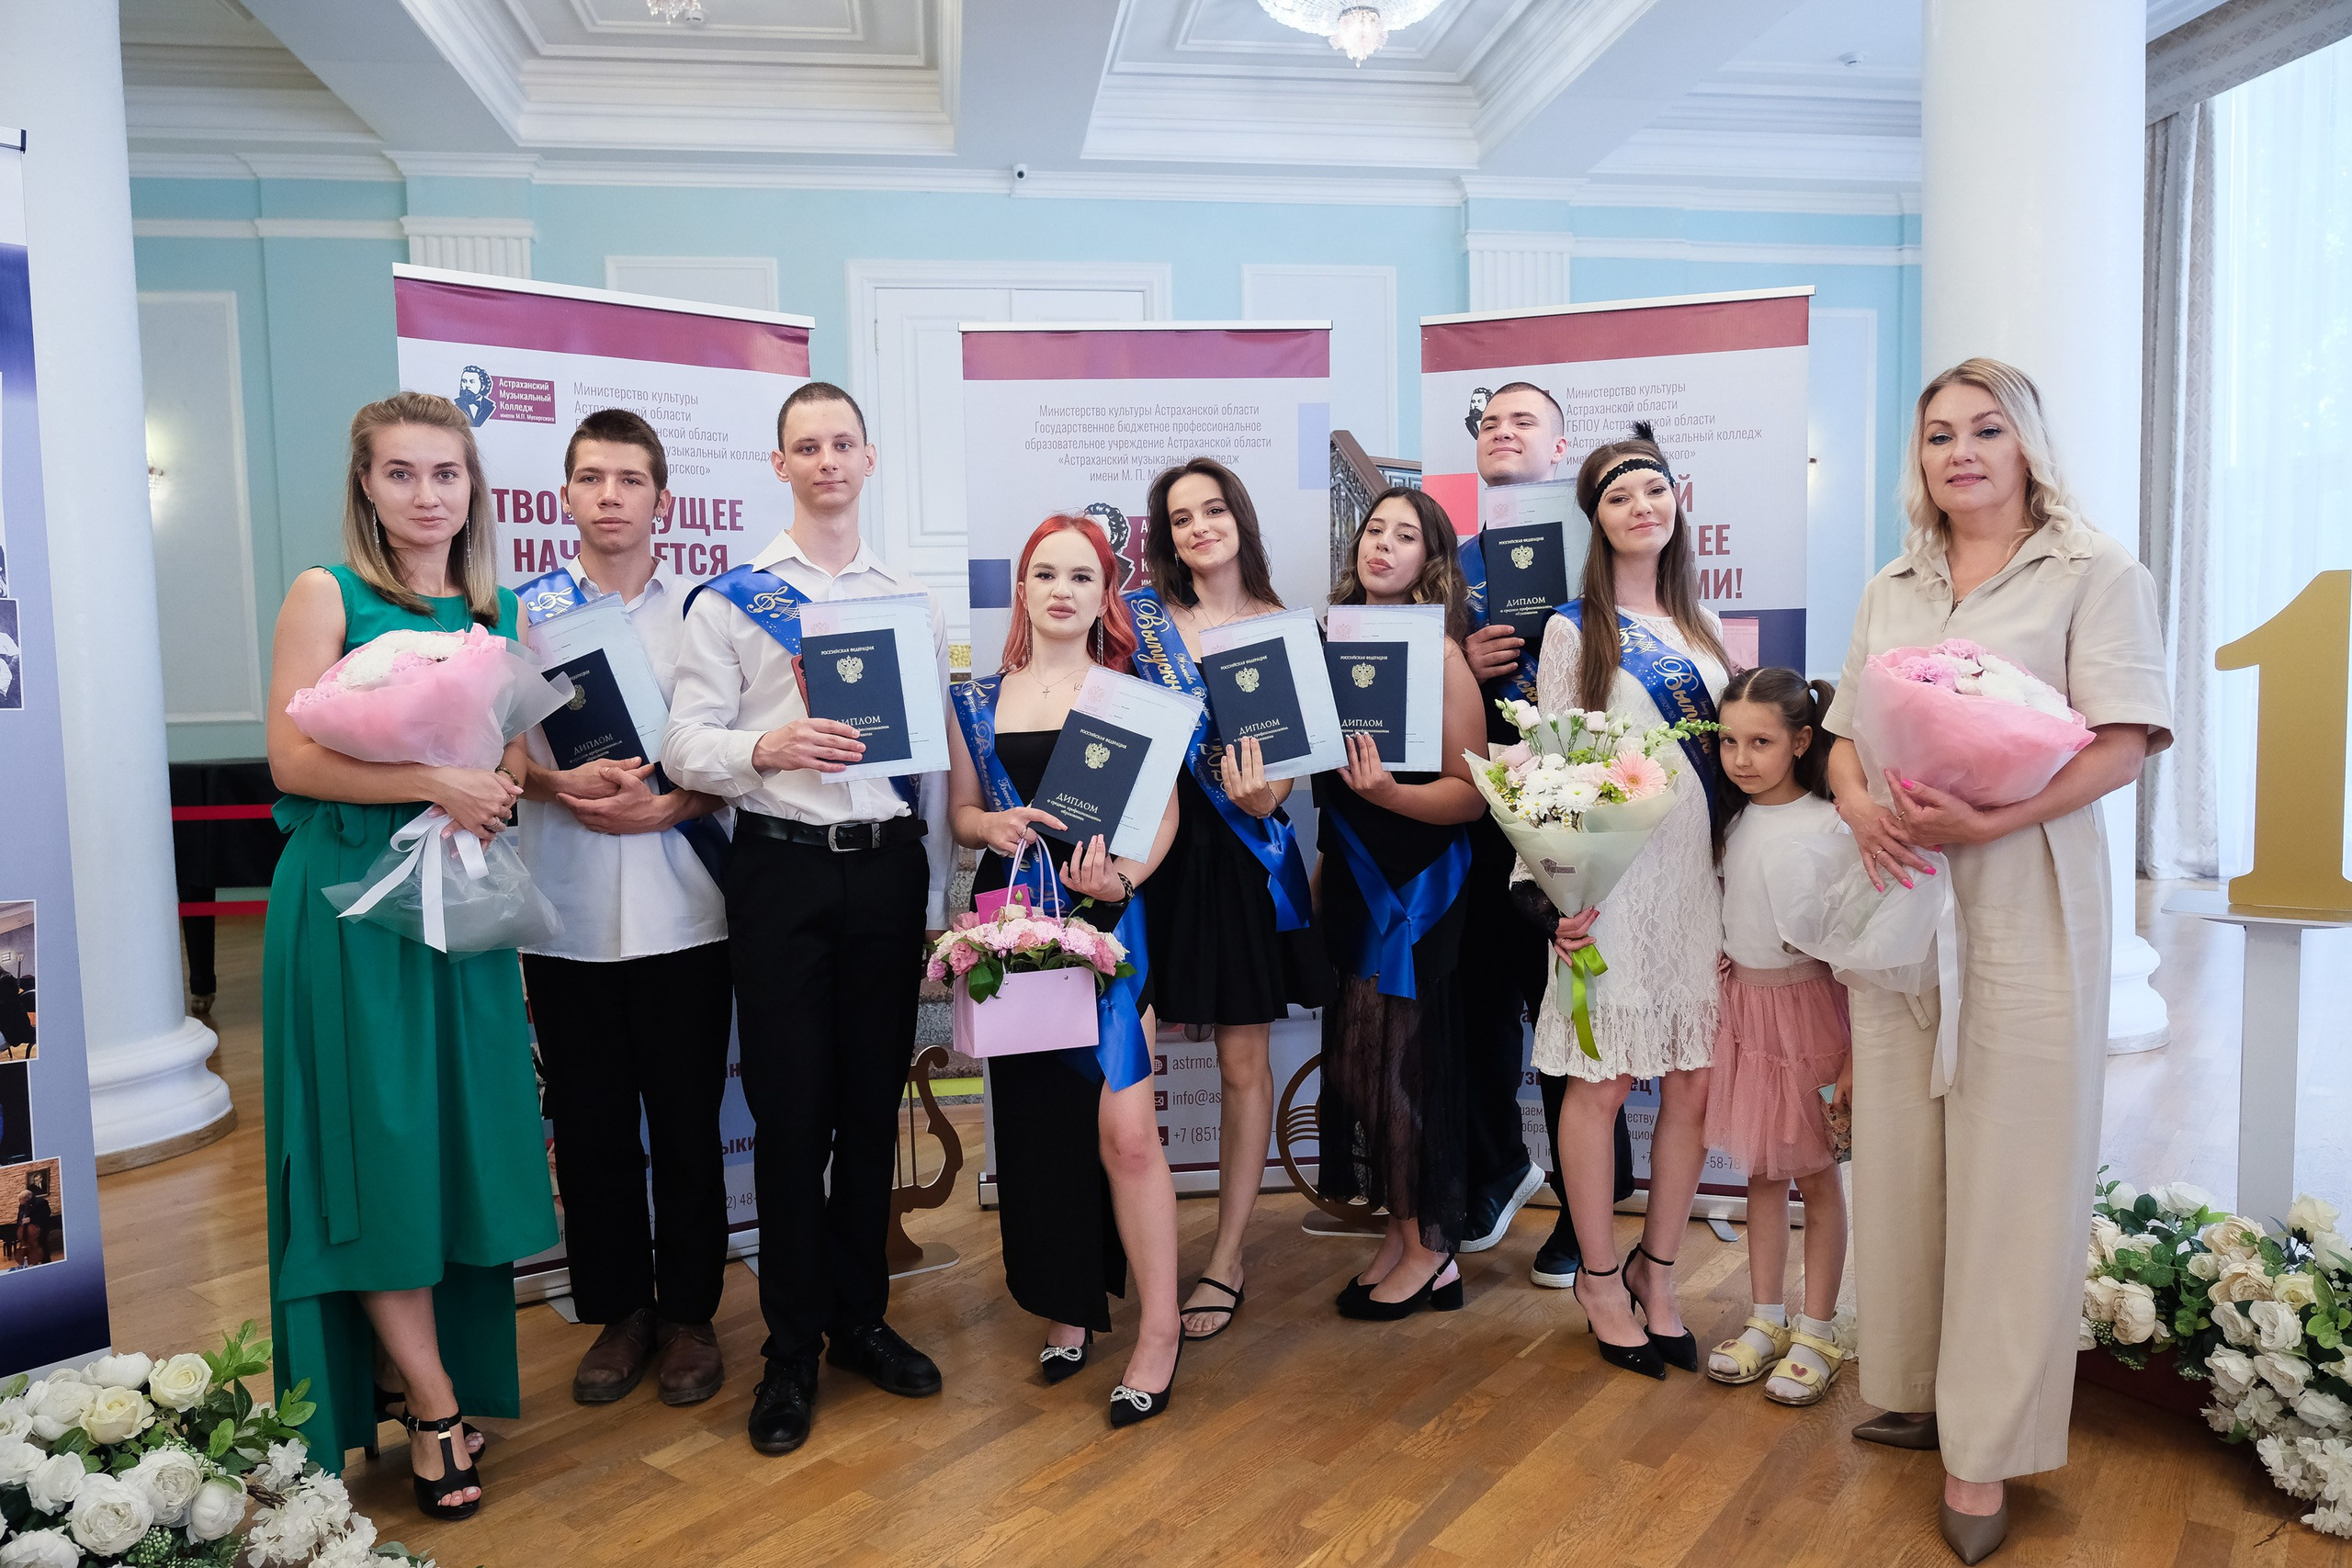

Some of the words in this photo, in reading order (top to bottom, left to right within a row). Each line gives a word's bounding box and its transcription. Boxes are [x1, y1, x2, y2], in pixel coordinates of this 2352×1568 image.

[499, 378, 549, 391] Астраханский
[1566, 384, 1636, 400] Министерство
[1639, 382, 1686, 399] культуры
[499, 389, 551, 402] Музыкальный
[573, 382, 649, 400] Министерство
[651, 391, 698, 405] культуры
[500, 400, 534, 412] Колледж
[1039, 404, 1106, 418] Министерство
[1108, 406, 1152, 418] культуры
[1155, 403, 1219, 418] Астраханской
[1221, 402, 1260, 416] области
[1566, 400, 1634, 417] Астраханской
[1637, 399, 1678, 412] области
[650, 407, 692, 422] области
[1566, 419, 1600, 432] ГБПОУ
[1674, 412, 1715, 426] области
[688, 426, 729, 442] области
[1035, 421, 1115, 435] Государственное
[1117, 420, 1170, 434] бюджетное
[1172, 420, 1261, 434] профессиональное
[1024, 437, 1105, 452] образовательное
[1108, 439, 1165, 451] учреждение
[1167, 436, 1231, 450] Астраханской
[1234, 435, 1272, 448] области
[1655, 430, 1714, 445] зыкальный
[1716, 428, 1762, 441] колледж
[663, 446, 728, 459] узыкальный
[1057, 454, 1129, 468] «Астраханский
[669, 463, 711, 476] ргского»
[1090, 471, 1118, 481] имени
[1122, 468, 1133, 481] М.
[1136, 468, 1145, 481] П.
[1507, 596, 1546, 607] ДИПЛОМ
[836, 715, 881, 728] ИПЛОМ
[1238, 718, 1281, 736] ДИПЛОМ
[1340, 718, 1384, 728] ДИПЛОМ
[574, 733, 614, 755] ДИПЛОМ
[1056, 792, 1099, 814] ДИПЛОМ
[1172, 1089, 1222, 1106] info@as
[1174, 1127, 1187, 1143] +7
[740, 1191, 757, 1206] 48-
